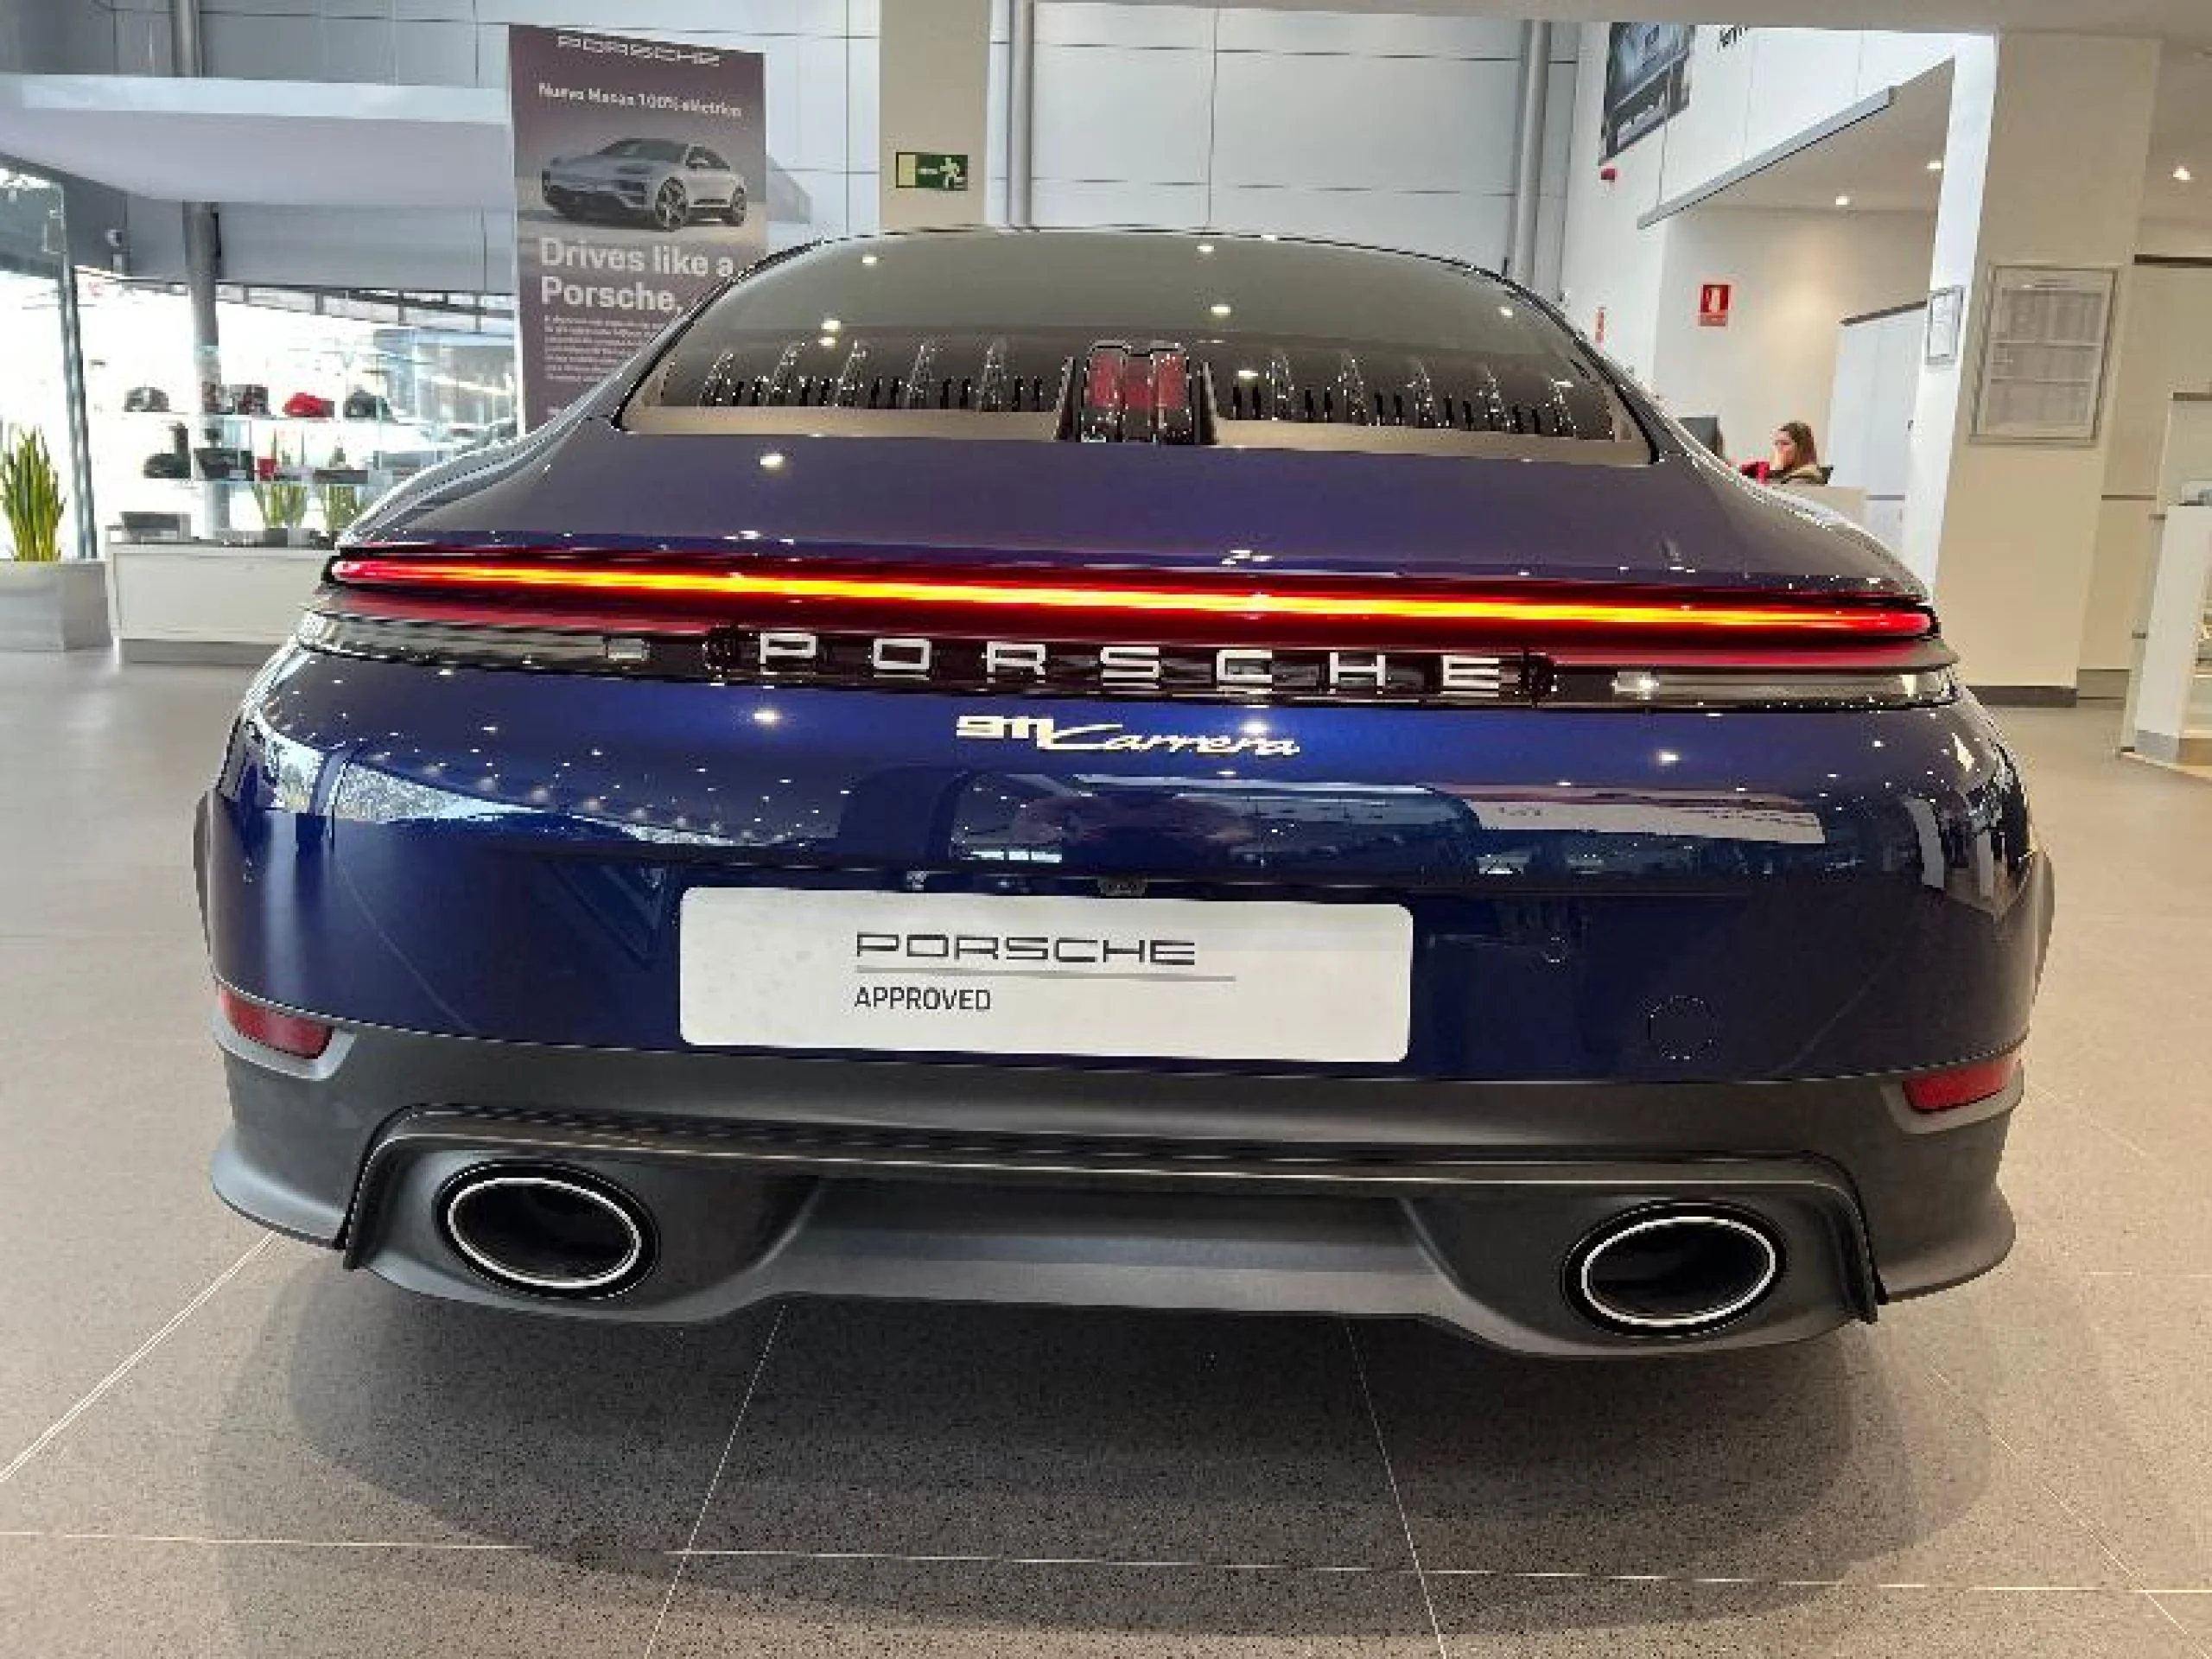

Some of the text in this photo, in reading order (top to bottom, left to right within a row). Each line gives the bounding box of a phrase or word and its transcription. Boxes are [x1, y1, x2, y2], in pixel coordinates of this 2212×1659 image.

[557, 35, 720, 67] PORSCHE
[538, 237, 734, 277] Drives like a
[759, 632, 1500, 691] PORSCHE
[956, 715, 1300, 757] 911 Carrera
[855, 931, 1196, 966] PORSCHE
[854, 986, 992, 1011] APPROVED
